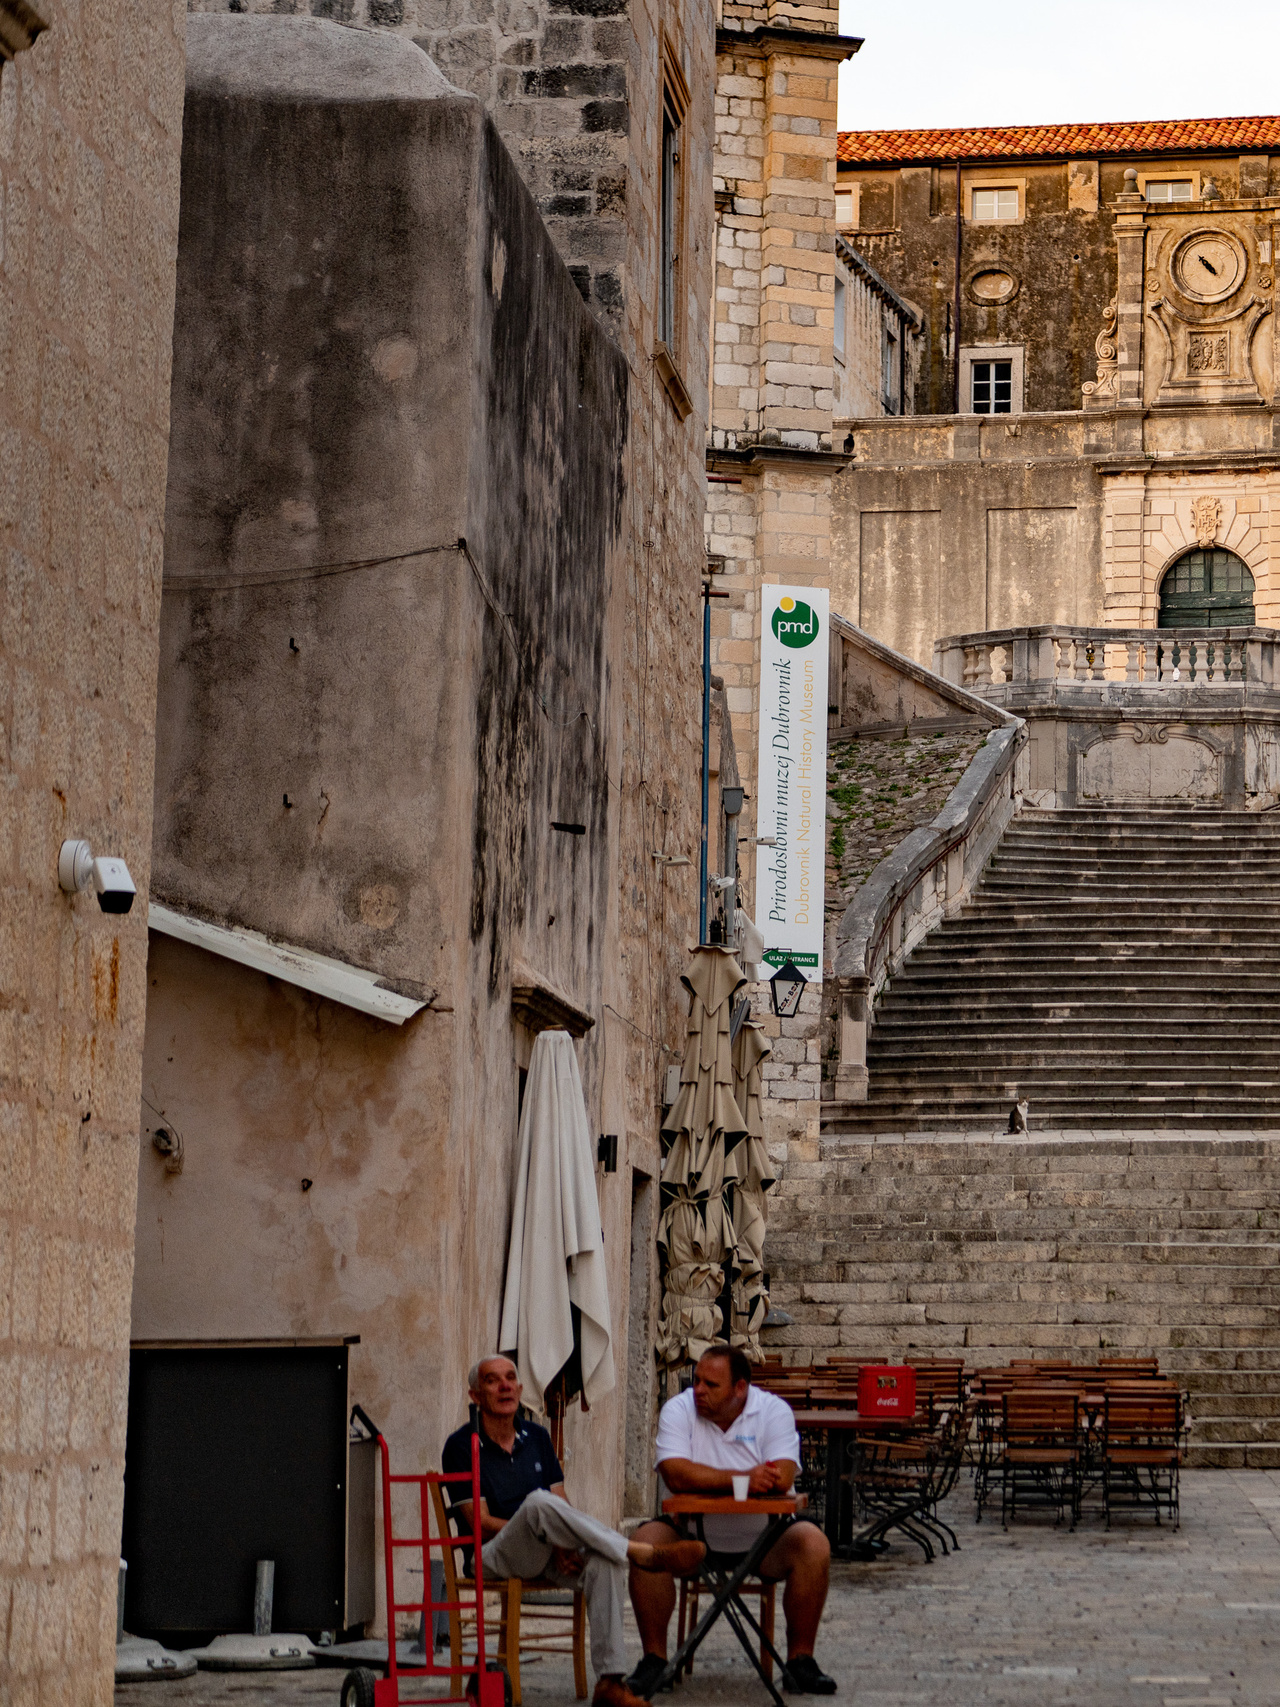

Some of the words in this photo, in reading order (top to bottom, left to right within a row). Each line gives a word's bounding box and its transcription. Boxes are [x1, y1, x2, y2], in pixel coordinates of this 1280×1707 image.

[777, 606, 813, 642] pmd
[771, 658, 791, 751] Dubrovnik
[799, 659, 814, 724] Museum
[774, 754, 796, 807] muzej
[797, 728, 816, 780] History
[796, 785, 812, 842] Natural
[768, 809, 788, 924] Prirodoslovni
[794, 847, 810, 924] Dubrovnik
